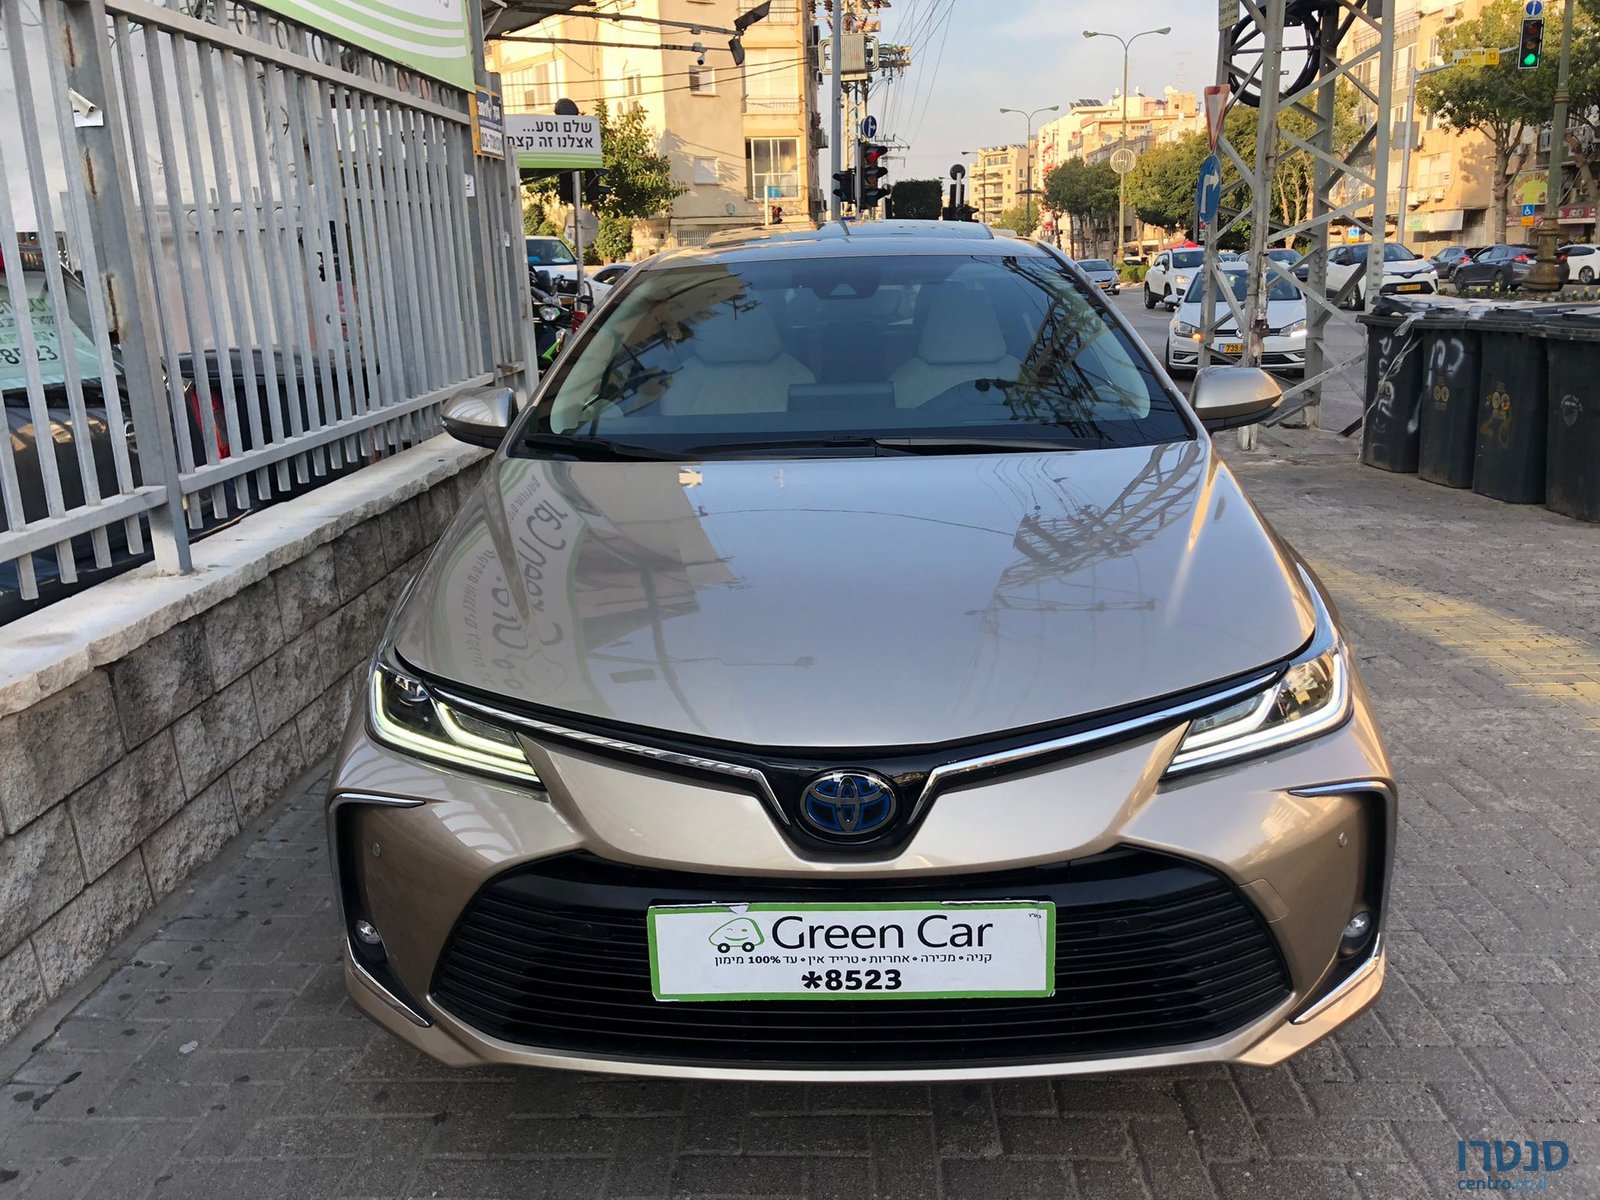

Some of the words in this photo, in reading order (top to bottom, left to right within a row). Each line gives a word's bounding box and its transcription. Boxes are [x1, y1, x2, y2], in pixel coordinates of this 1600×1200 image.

[523, 121, 558, 133] וסע...
[563, 120, 592, 133] שלם
[539, 136, 553, 148] זה
[557, 134, 593, 148] אצלנו
[772, 915, 904, 949] Green
[917, 914, 993, 948] Car
[715, 956, 745, 966] מימון
[748, 956, 781, 964] 100%
[783, 956, 798, 964] עד
[808, 956, 825, 966] אין
[828, 955, 859, 963] טרייד
[869, 954, 910, 963] אחריות
[920, 953, 956, 962] מכירה
[966, 953, 992, 964] קניה
